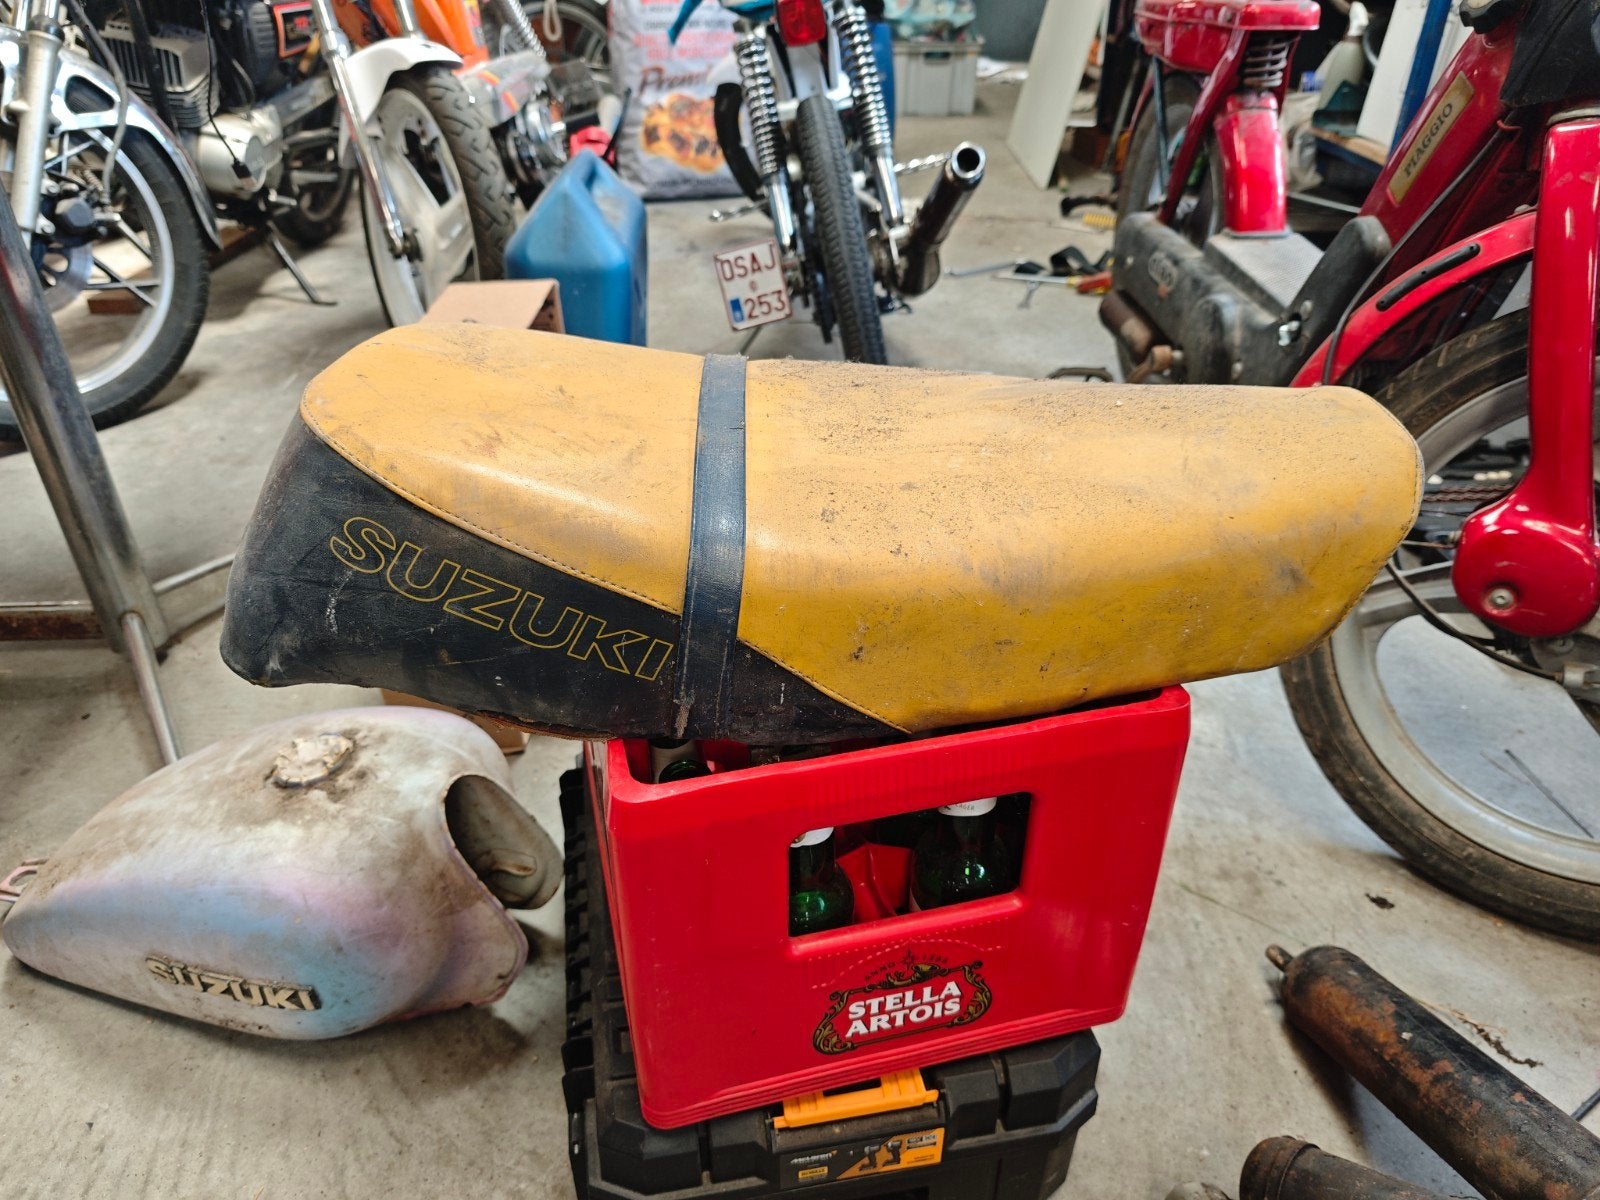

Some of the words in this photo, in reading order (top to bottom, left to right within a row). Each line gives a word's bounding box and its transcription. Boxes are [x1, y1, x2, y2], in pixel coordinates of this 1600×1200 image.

[1404, 102, 1453, 178] PIAGGIO
[744, 289, 786, 319] 253
[329, 516, 674, 681] SUZUKI
[144, 956, 318, 1012] SUZUKI
[848, 980, 962, 1020] STELLA
[845, 997, 961, 1038] ARTOIS
